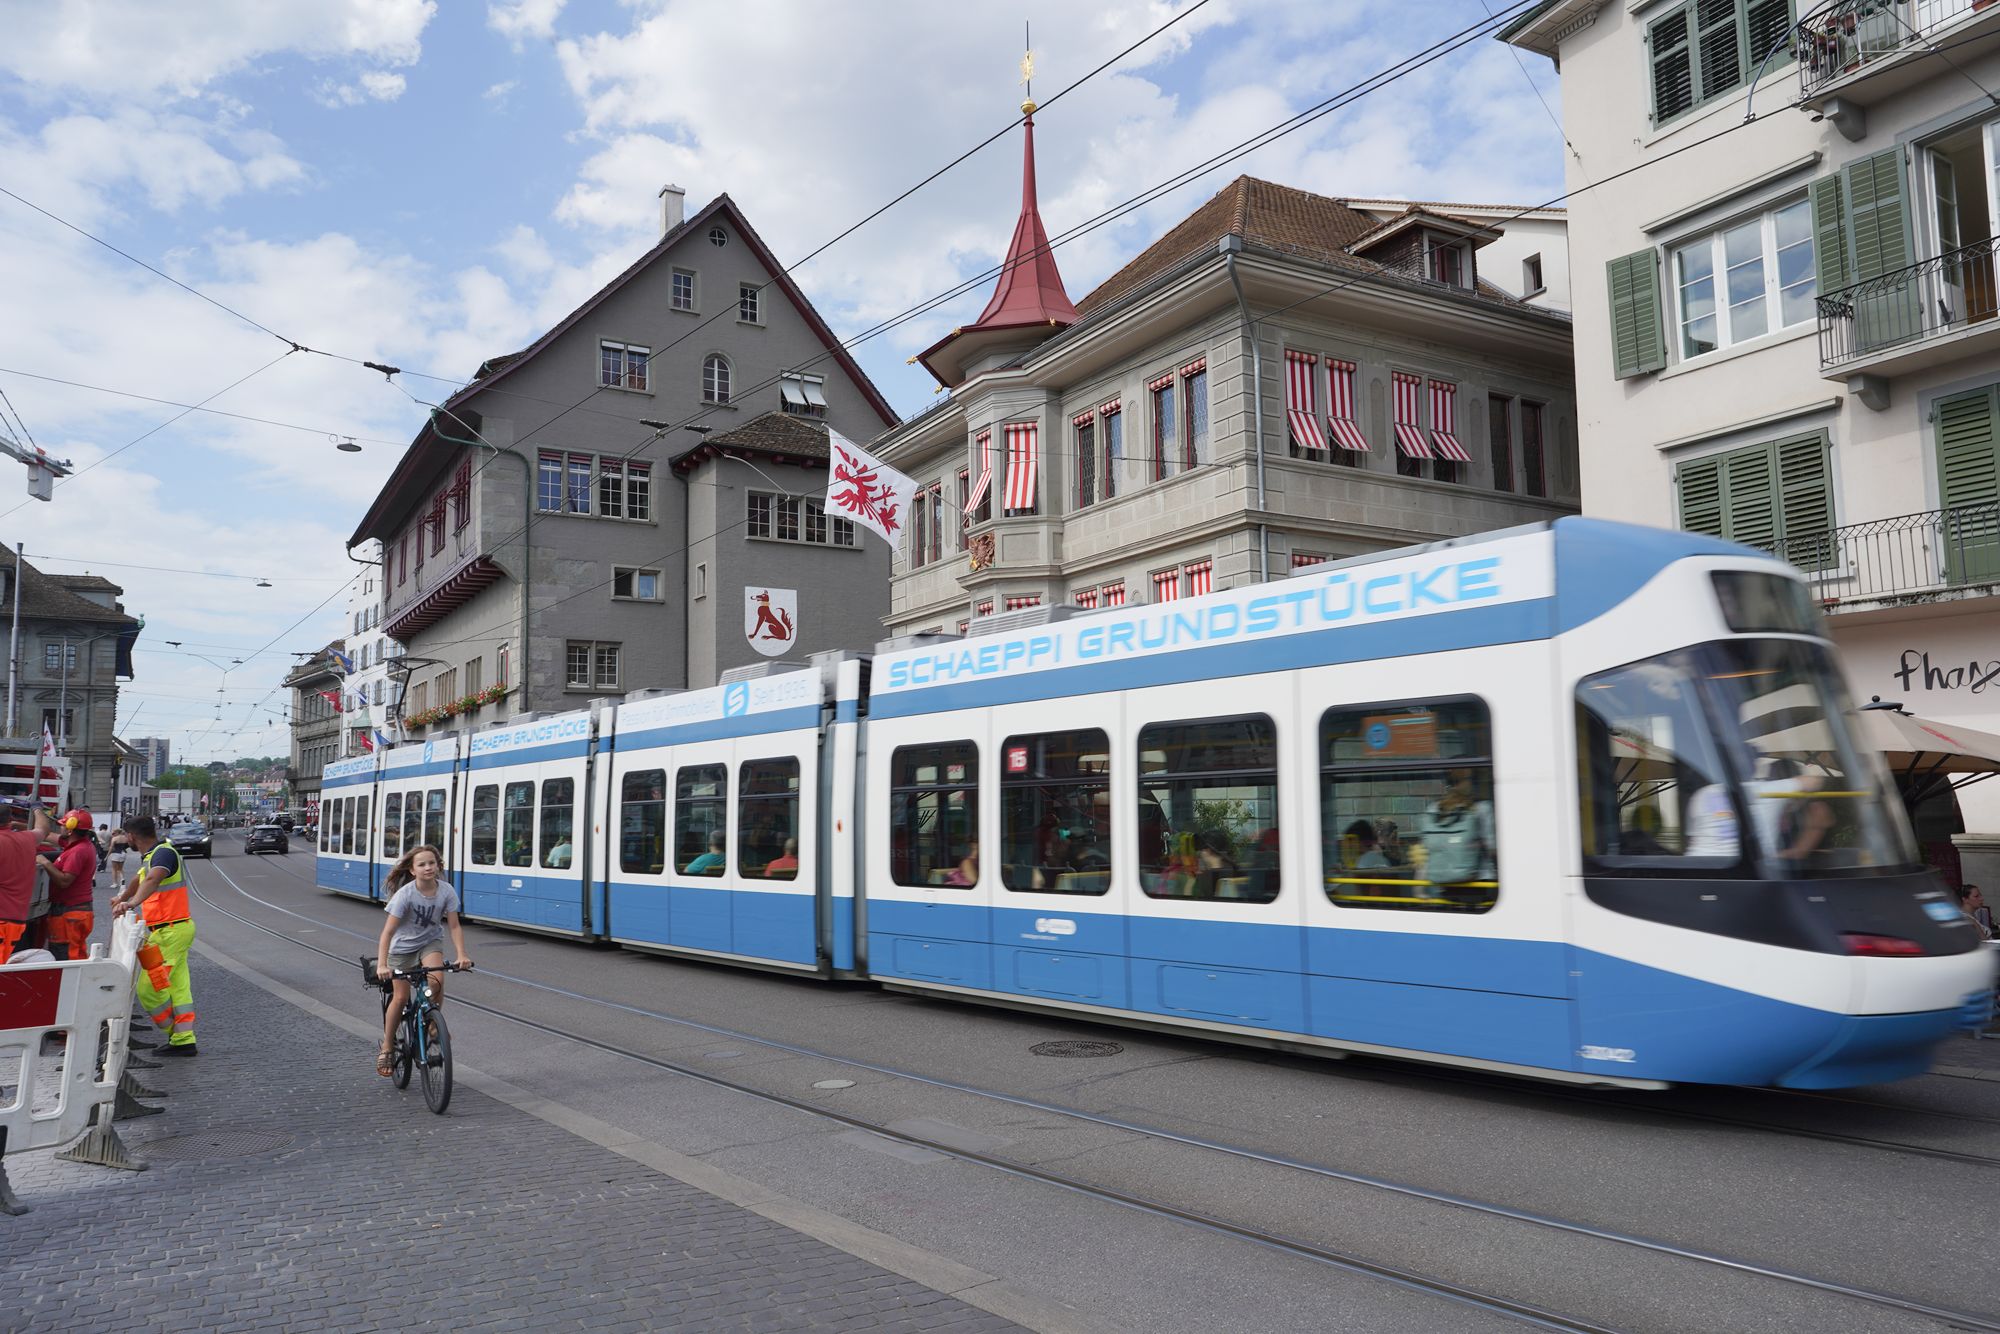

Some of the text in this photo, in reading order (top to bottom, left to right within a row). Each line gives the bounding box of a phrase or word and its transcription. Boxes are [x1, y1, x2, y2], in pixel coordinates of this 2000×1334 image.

[888, 555, 1502, 689] SCHAEPPI GRUNDSTÜCKE
[472, 732, 513, 752] SCHAEPPI
[514, 719, 588, 745] GRUNDSTÜCKE
[1008, 750, 1027, 768] 15
